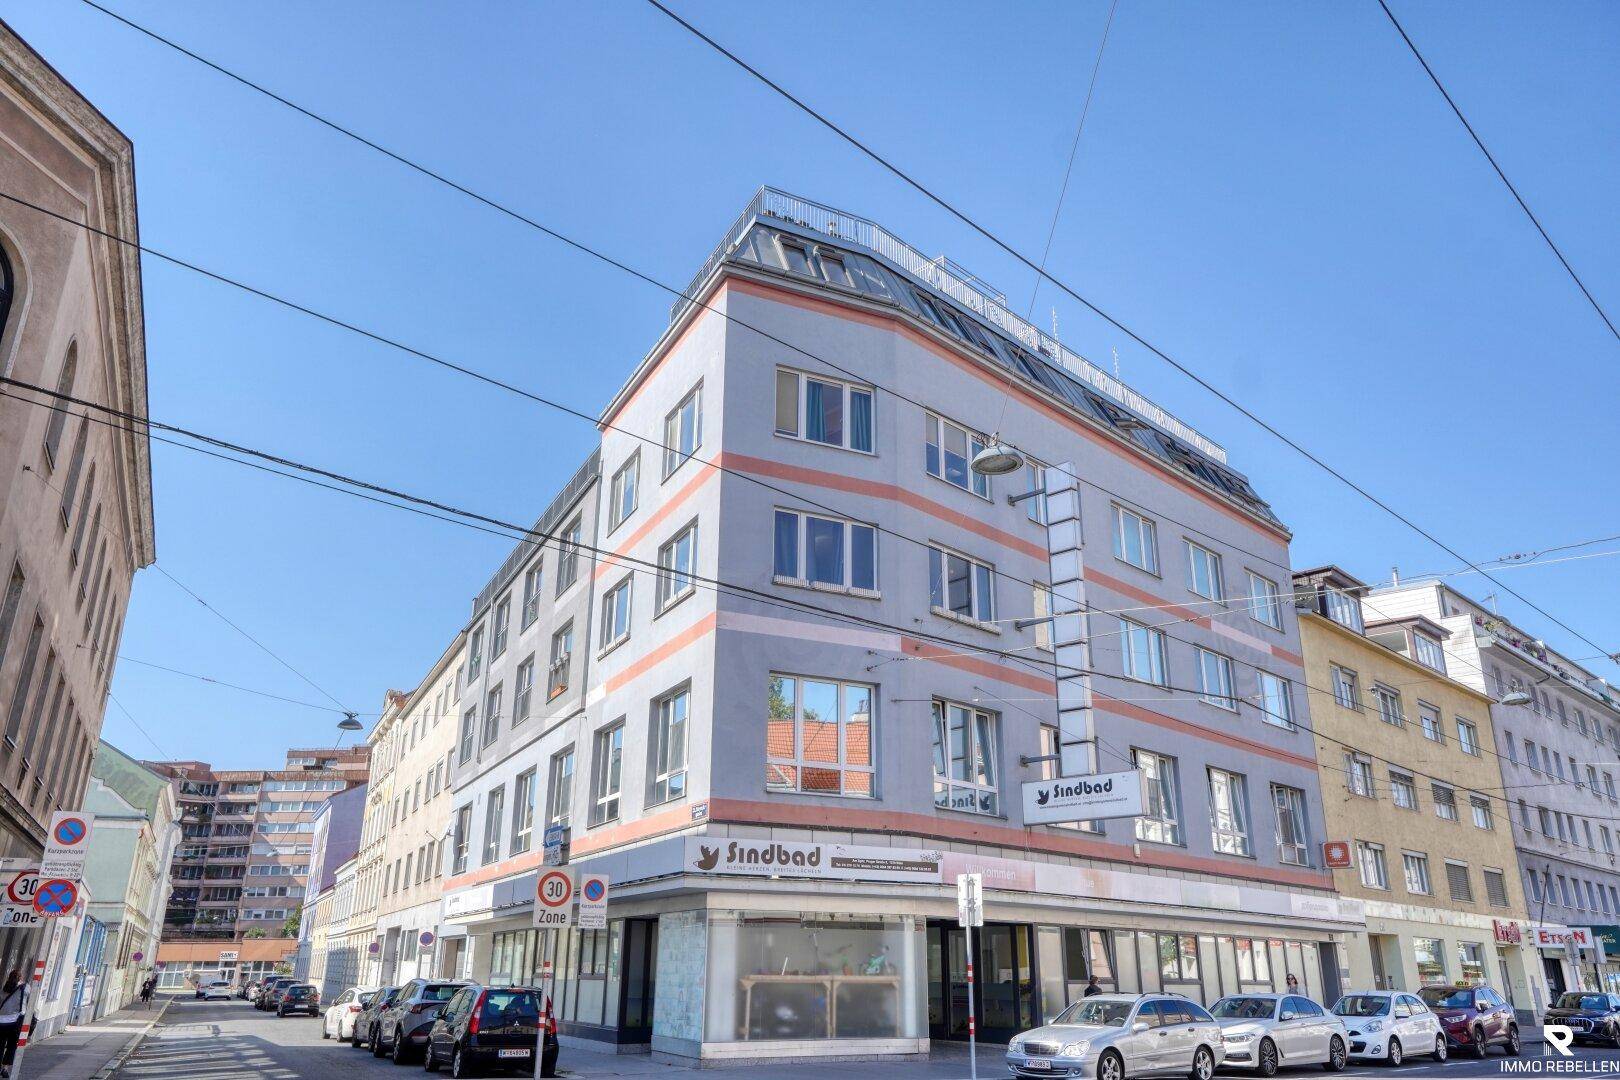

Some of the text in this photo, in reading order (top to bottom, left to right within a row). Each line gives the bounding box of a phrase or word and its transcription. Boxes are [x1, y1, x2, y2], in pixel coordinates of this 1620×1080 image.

[1053, 778, 1113, 798] Sindbad
[727, 842, 820, 867] Sindbad
[547, 881, 563, 898] 30
[539, 909, 566, 924] Zone
